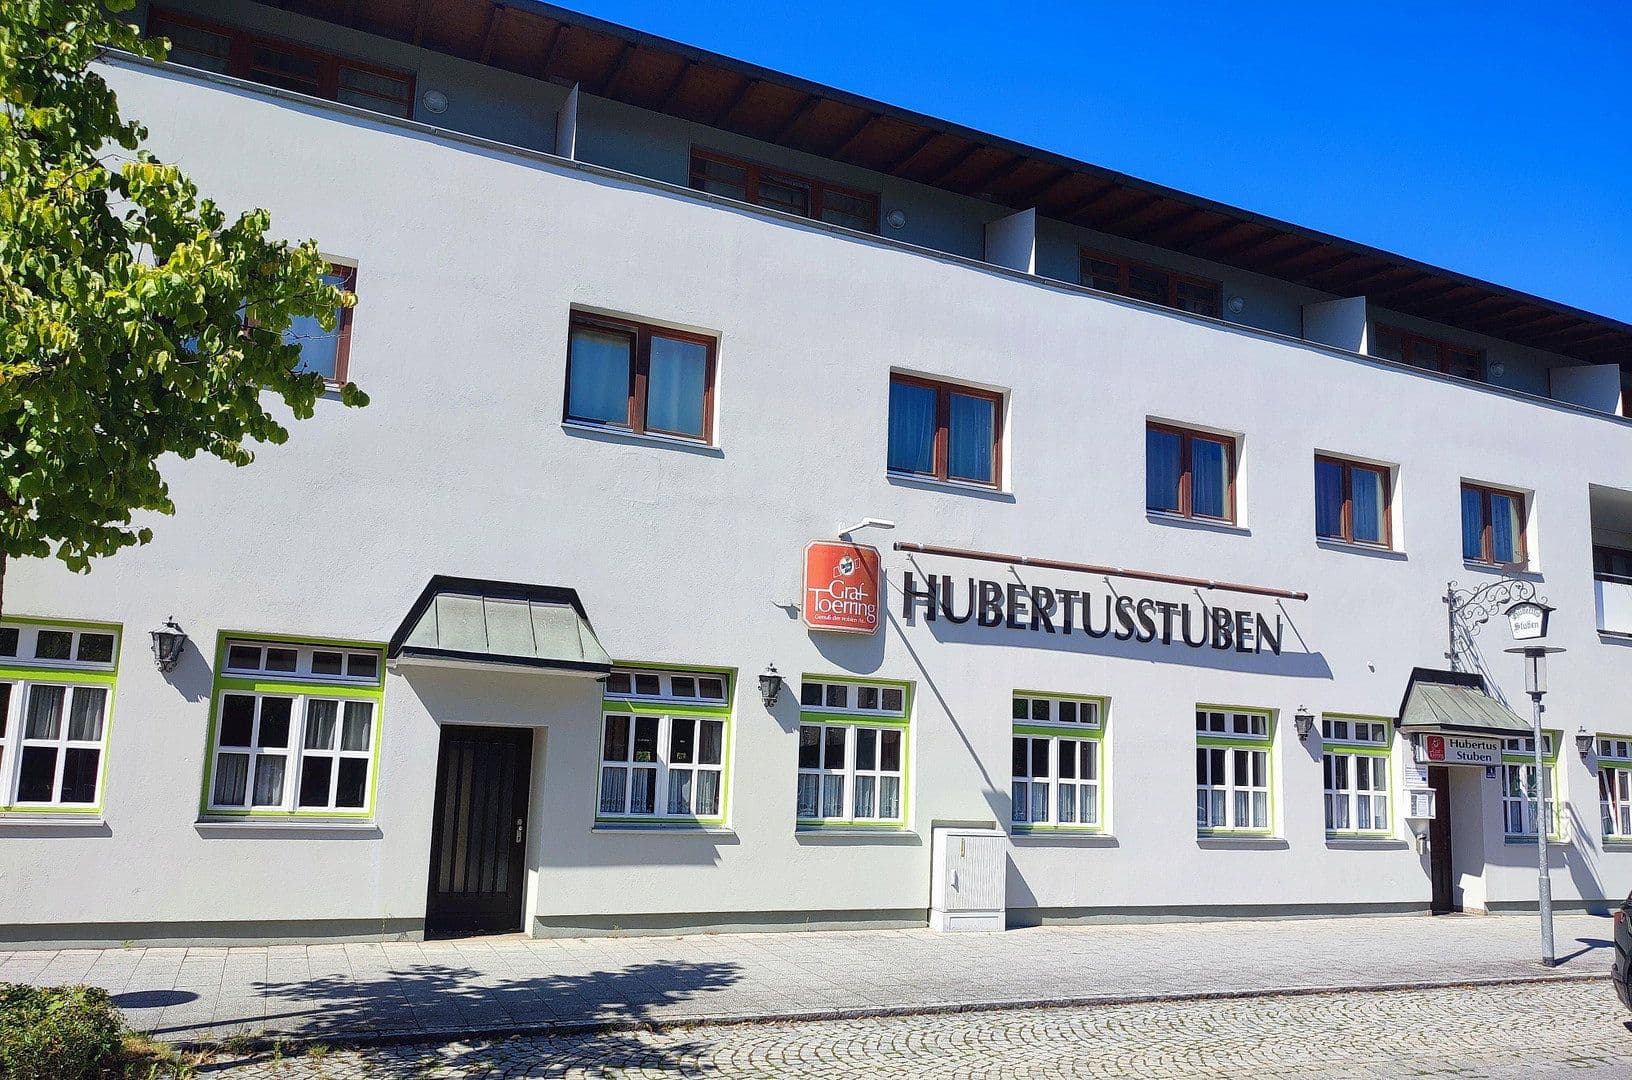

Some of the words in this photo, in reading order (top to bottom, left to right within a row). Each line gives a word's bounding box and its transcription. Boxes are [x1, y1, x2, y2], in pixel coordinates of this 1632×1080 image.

[829, 579, 869, 601] Graf
[808, 587, 876, 624] Toerring
[903, 571, 1282, 656] HUBERTUSSTUBEN
[1449, 739, 1497, 751] Hubertus
[1456, 750, 1492, 761] Stuben
